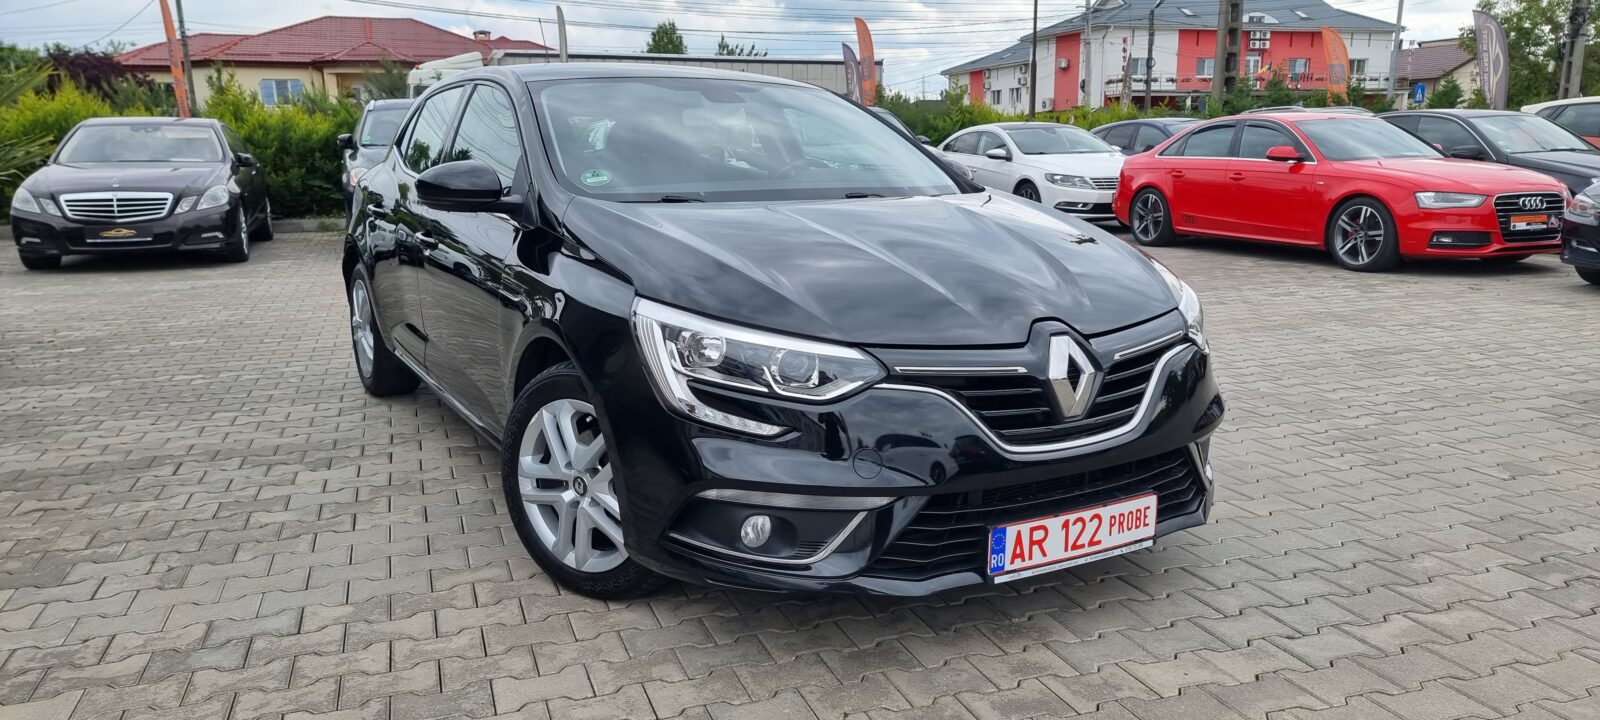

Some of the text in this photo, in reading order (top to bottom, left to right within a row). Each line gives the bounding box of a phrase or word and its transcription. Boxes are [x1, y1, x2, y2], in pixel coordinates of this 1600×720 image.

[1010, 506, 1151, 565] AR 122 PROBE
[991, 553, 1004, 568] RO
